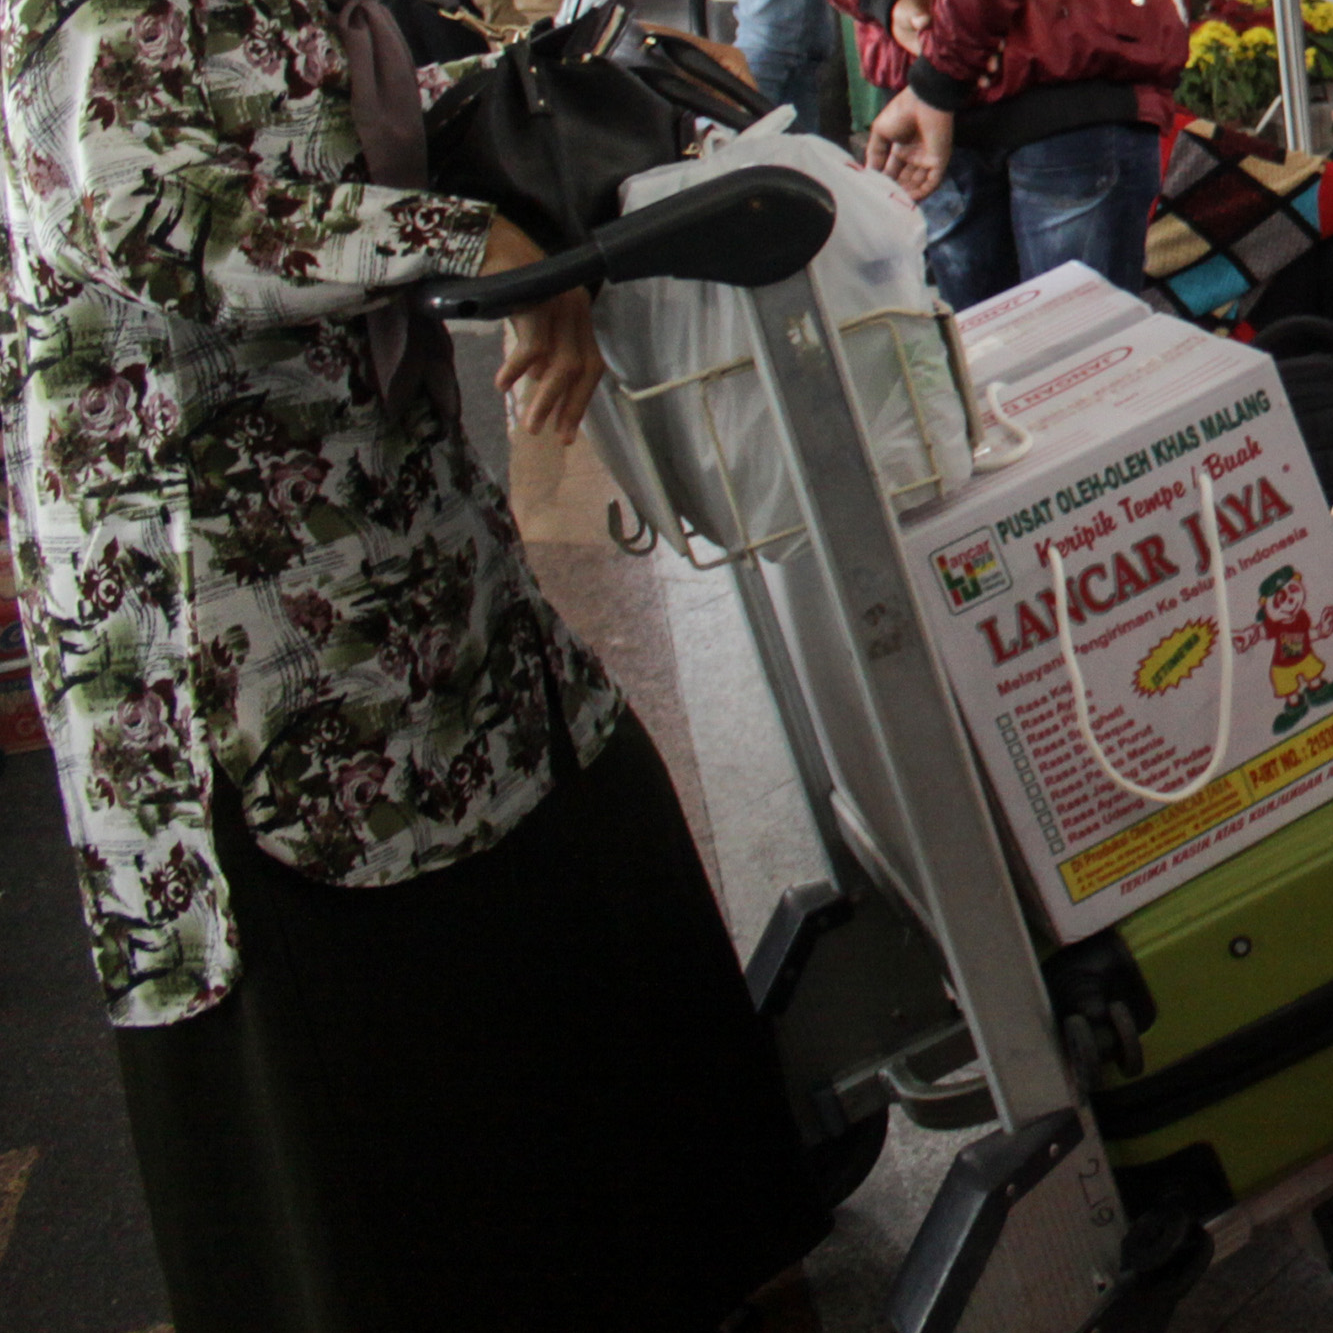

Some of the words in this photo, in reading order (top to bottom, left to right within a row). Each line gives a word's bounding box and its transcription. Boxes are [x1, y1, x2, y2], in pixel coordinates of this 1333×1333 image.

[997, 499, 1052, 543] PUSAT
[1057, 452, 1151, 512] OLEH-OLEH
[1153, 426, 1199, 464] KHAS
[1201, 391, 1269, 439] MALANG
[1036, 512, 1116, 567] Keripik
[1119, 482, 1185, 522] Tempe
[982, 538, 1176, 662] LANCAR
[1183, 479, 1291, 573] JAYA
[997, 655, 1064, 695] Melayani
[1157, 599, 1177, 614] Ke
[1239, 529, 1307, 570] Indonesia
[1015, 696, 1048, 716] Rasa
[1050, 681, 1072, 698] Kej
[1021, 710, 1054, 730] Rasa
[1027, 724, 1060, 744] Rasa
[1033, 738, 1066, 758] Rasa
[1039, 753, 1071, 772] Rasa
[1045, 767, 1077, 786] Rasa
[1118, 725, 1153, 748] Purut
[1051, 780, 1083, 800] Rasa
[1127, 738, 1164, 760] Manis
[1057, 794, 1089, 814] Rasa
[1141, 747, 1175, 770] Bakar
[1062, 809, 1095, 828] Rasa
[1174, 746, 1211, 768] Pedas
[1068, 822, 1100, 842] Rasa
[1103, 799, 1144, 824] Udang
[1121, 862, 1166, 894] TERIMA
[1173, 838, 1210, 866] KASIH
[1214, 818, 1244, 842] ATAS
